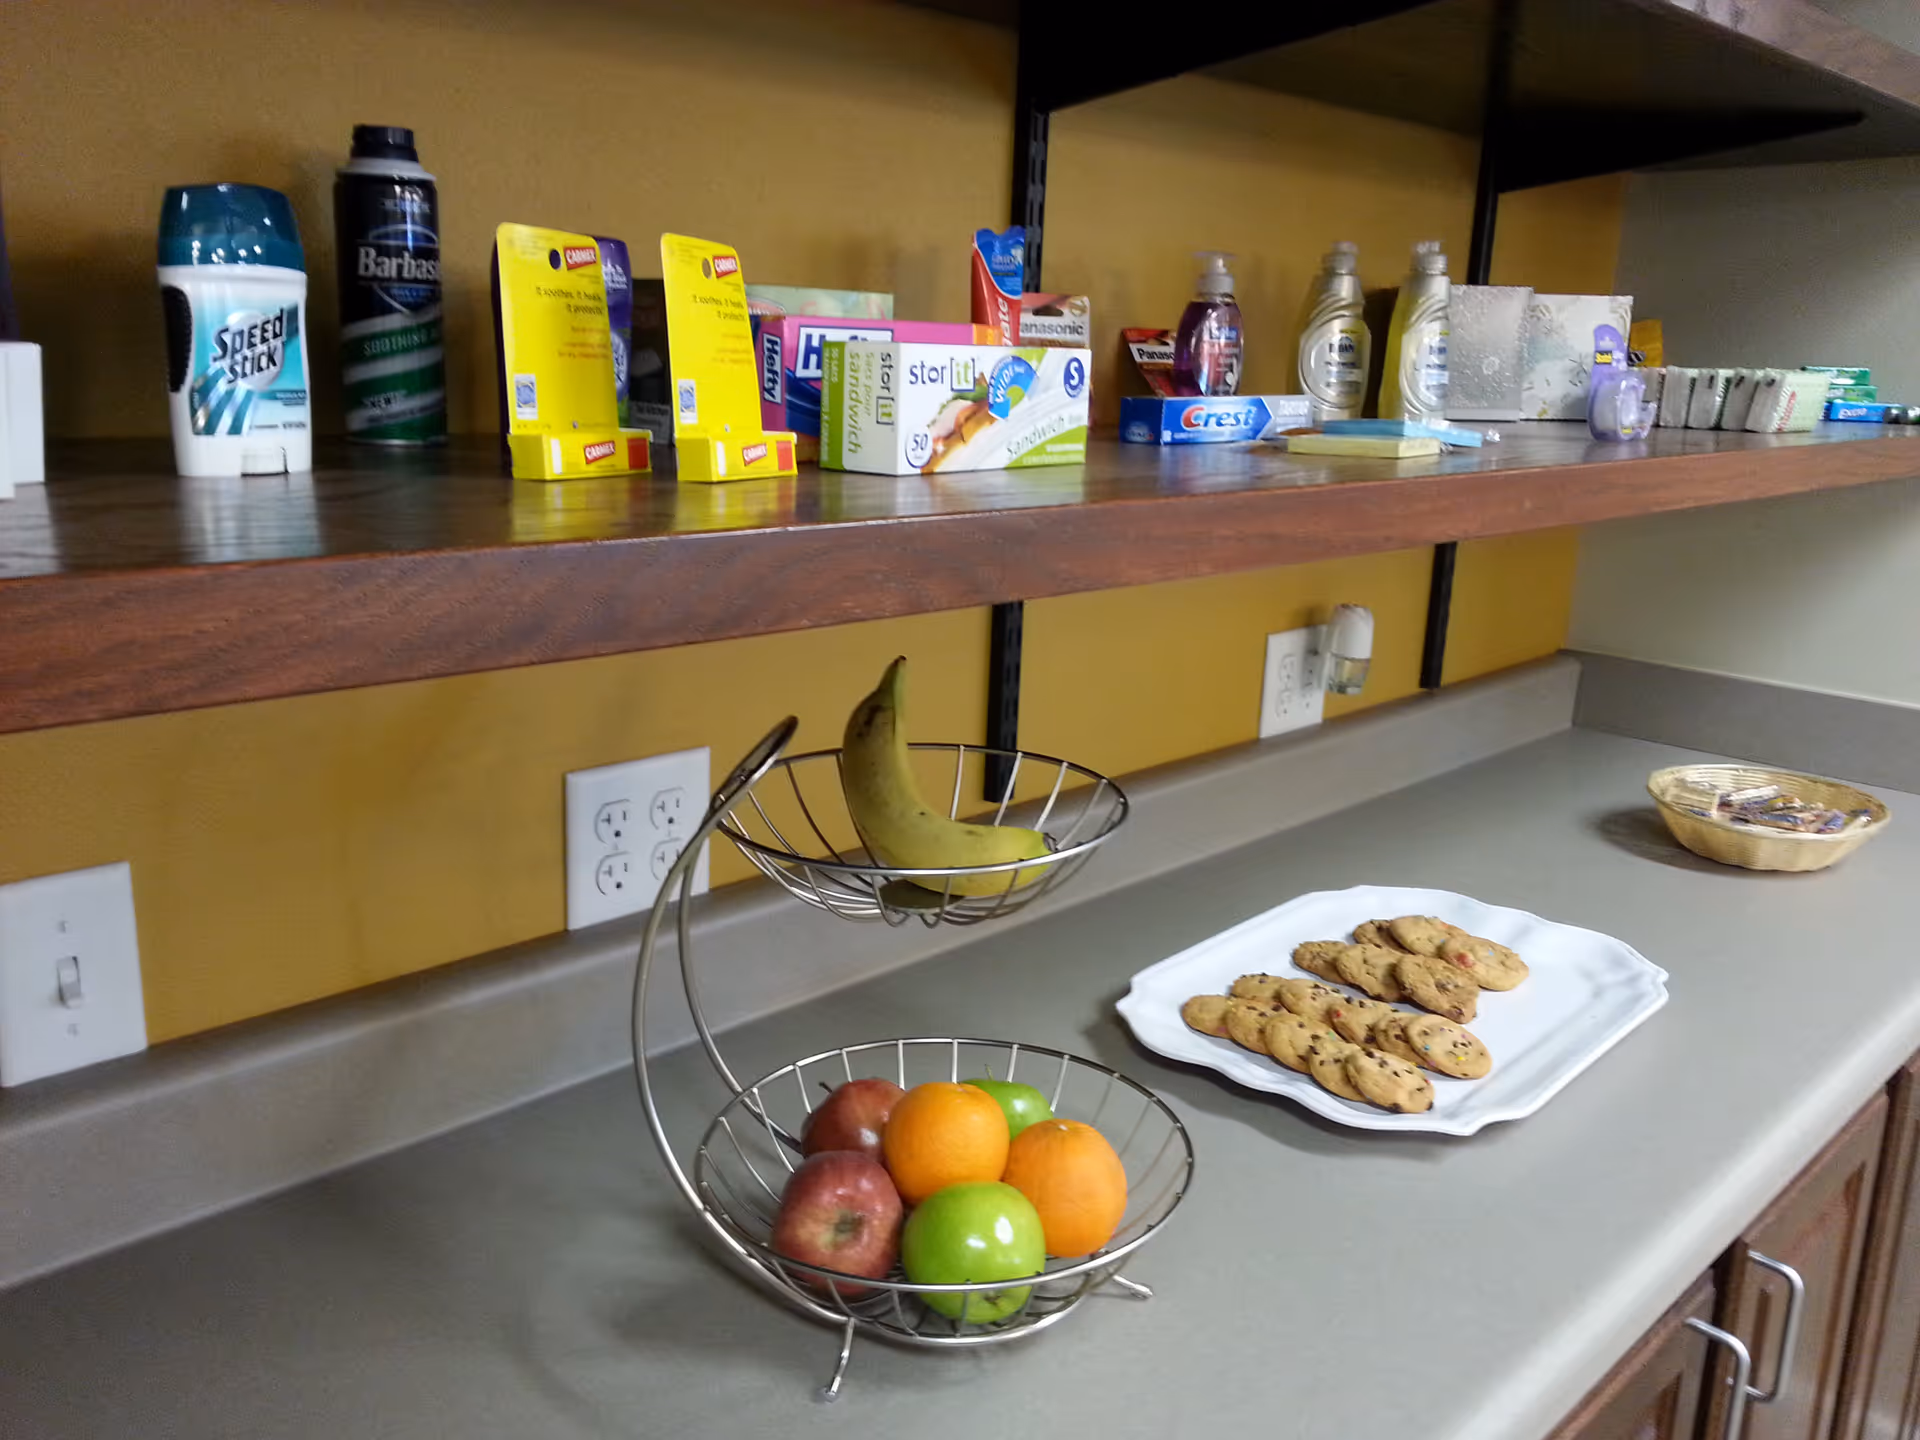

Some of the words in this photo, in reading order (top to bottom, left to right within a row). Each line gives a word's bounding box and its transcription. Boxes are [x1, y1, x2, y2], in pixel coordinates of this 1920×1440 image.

[1019, 319, 1084, 336] anasonic
[764, 336, 780, 401] Hefty
[908, 360, 947, 386] stor
[1181, 404, 1253, 430] Crest
[911, 432, 929, 452] 50
